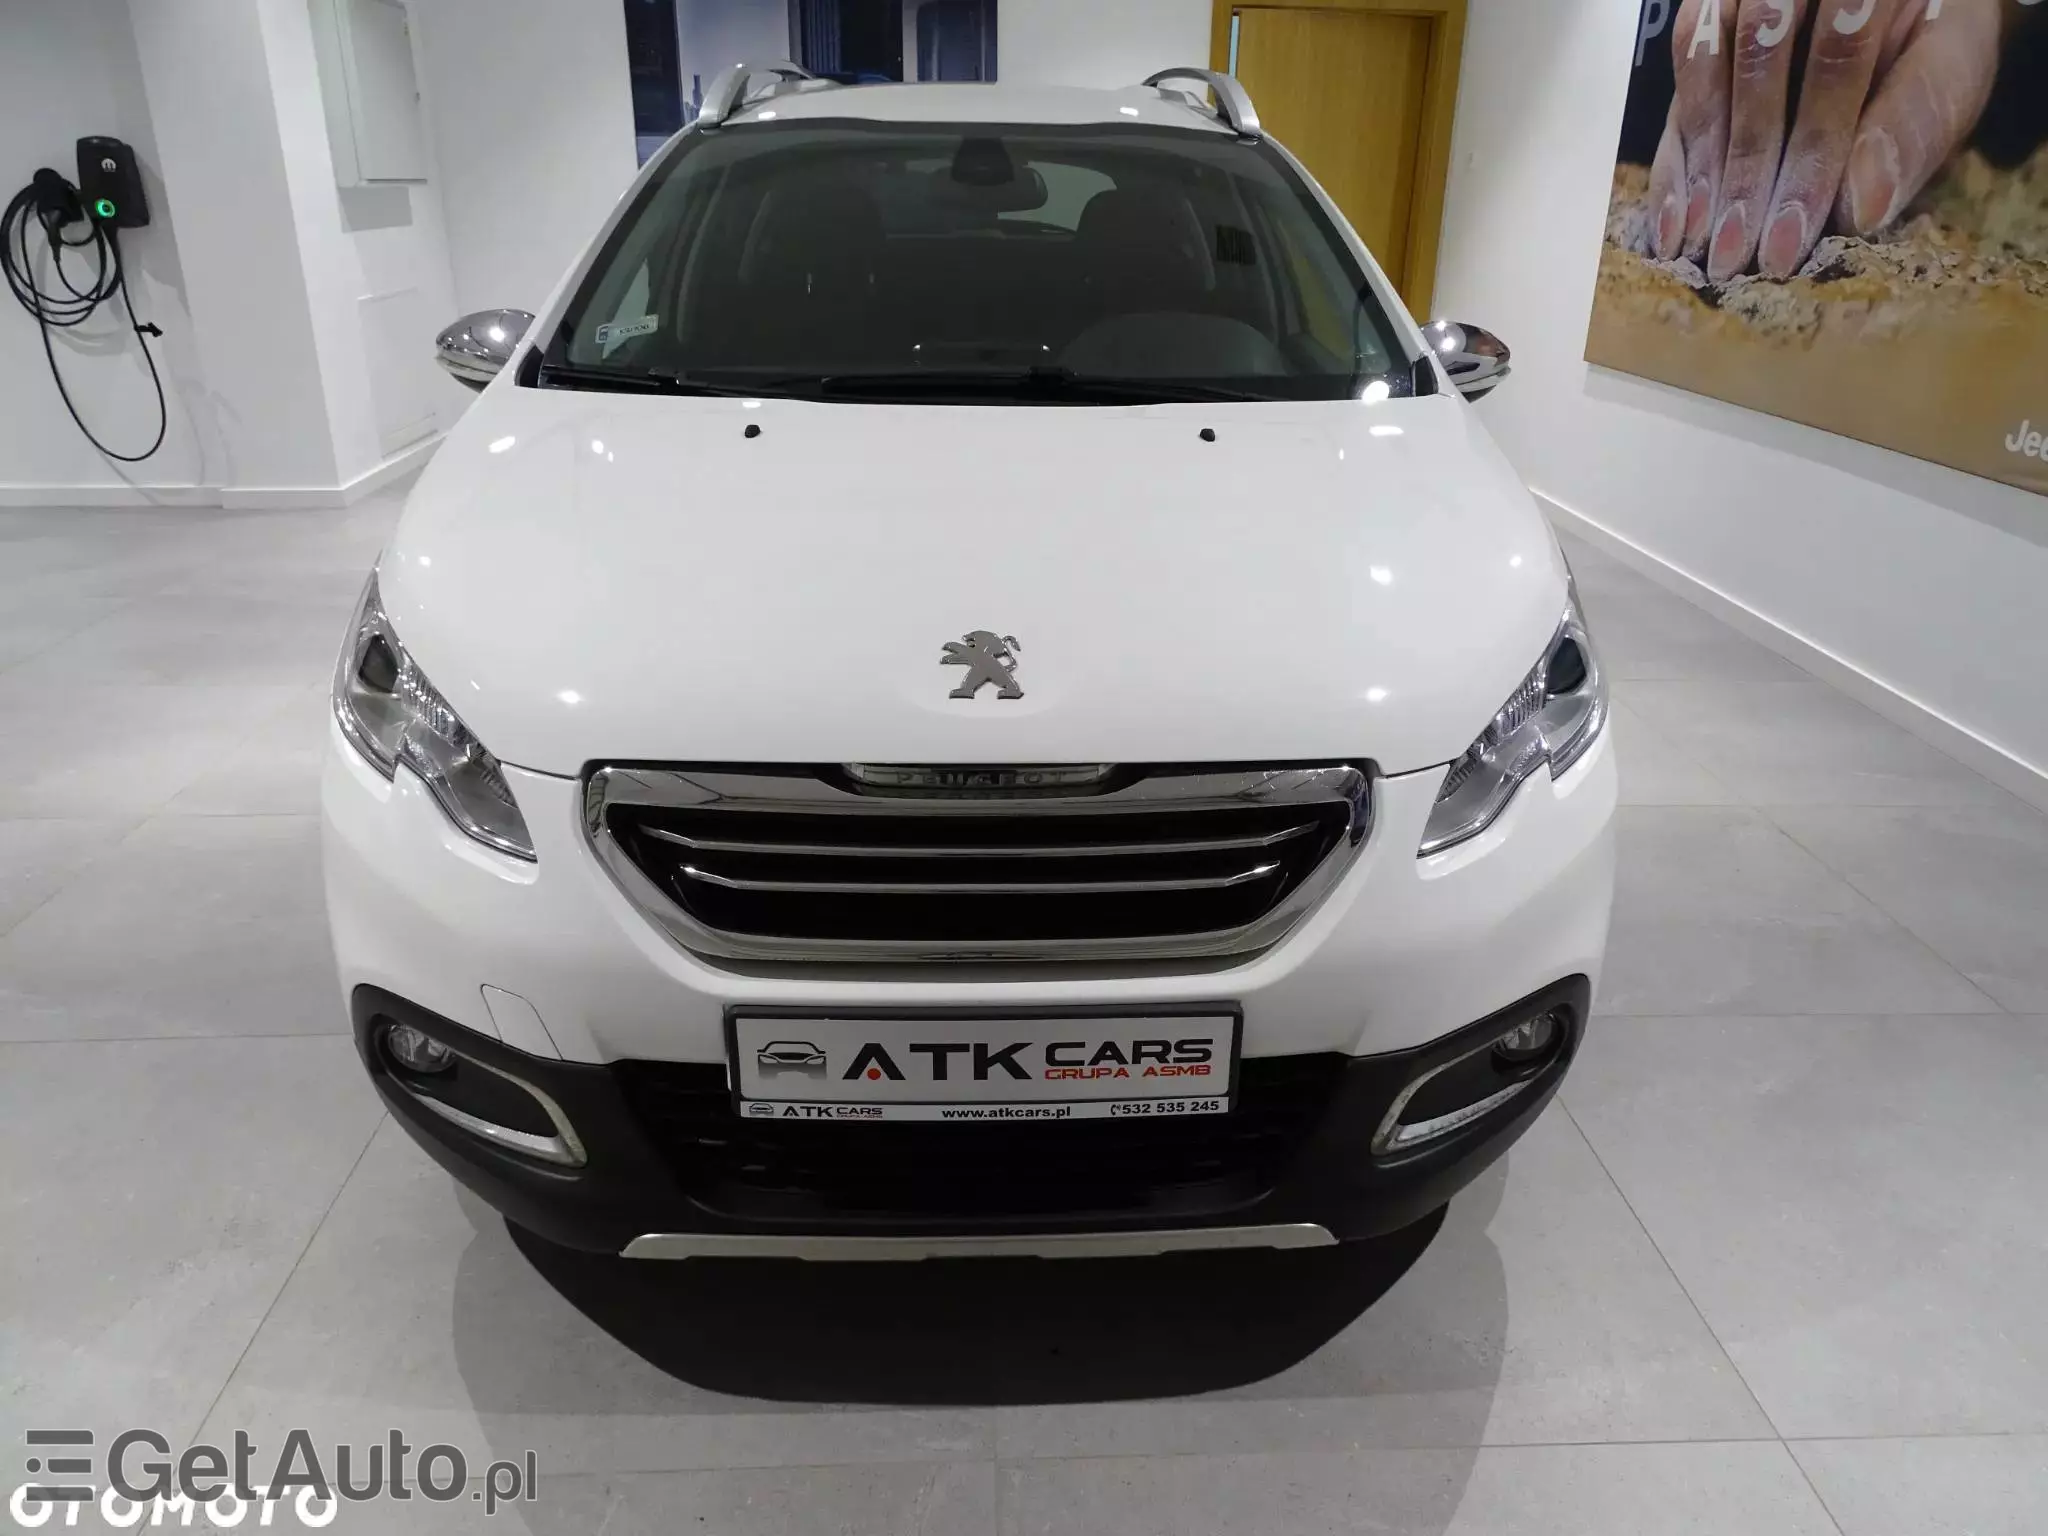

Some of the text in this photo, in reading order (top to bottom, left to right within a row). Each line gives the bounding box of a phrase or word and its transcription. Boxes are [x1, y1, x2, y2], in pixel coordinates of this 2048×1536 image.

[842, 1039, 1213, 1080] ATK CARS
[1045, 1065, 1212, 1080] GRUPA ASMB
[782, 1106, 833, 1117] ATK
[837, 1107, 883, 1115] CARS
[942, 1106, 1071, 1119] www.atkcars.pl
[1122, 1101, 1219, 1115] 532 535 245
